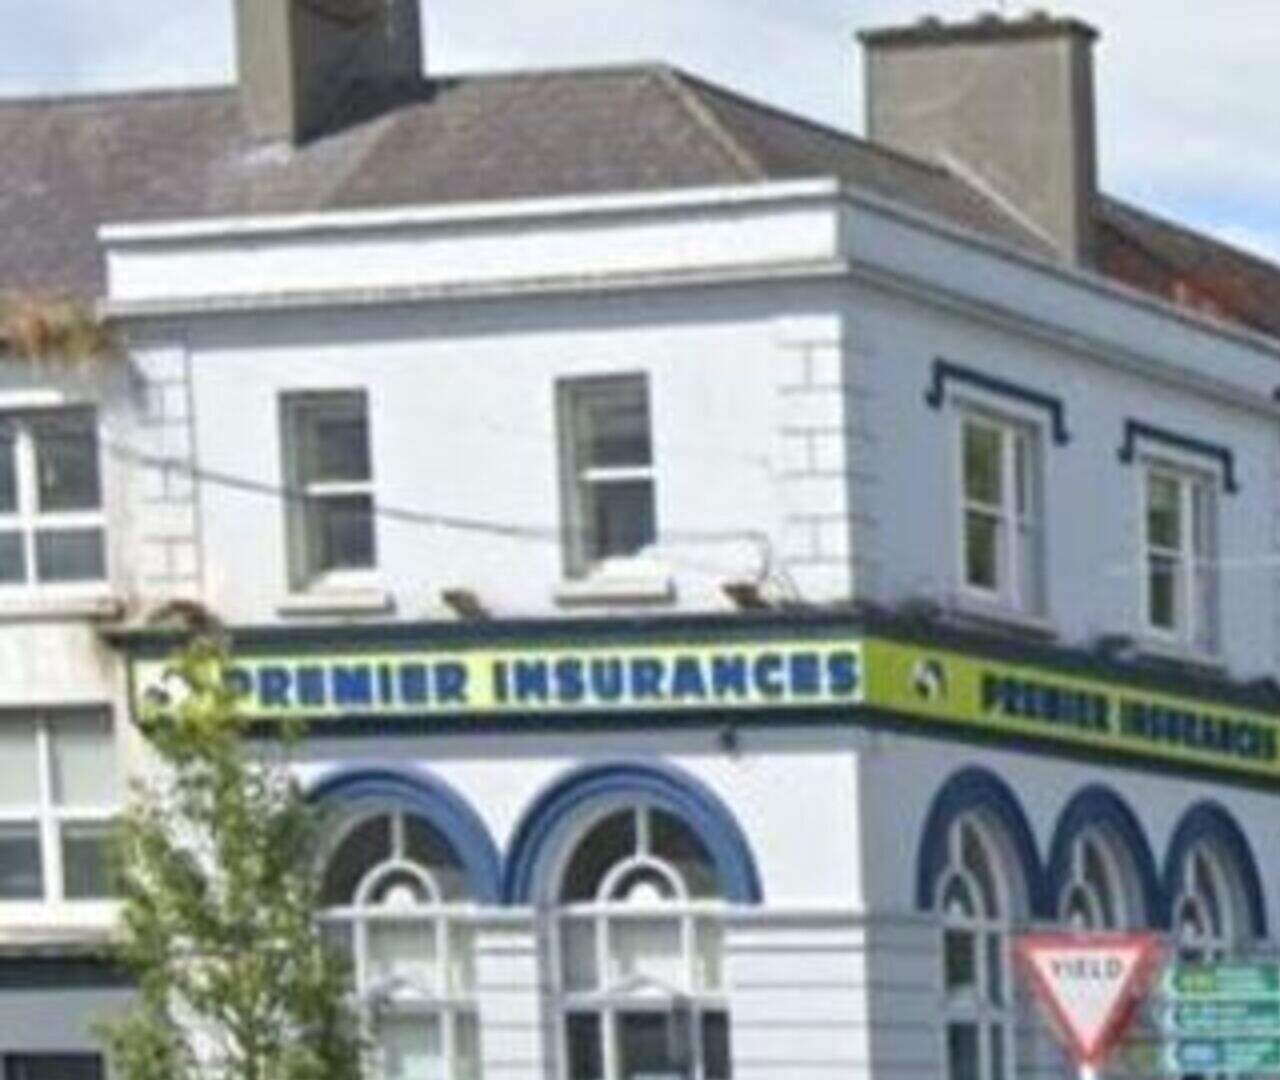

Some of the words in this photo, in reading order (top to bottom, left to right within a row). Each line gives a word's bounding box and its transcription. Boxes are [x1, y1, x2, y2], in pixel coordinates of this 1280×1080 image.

[224, 661, 468, 708] PREMIER
[493, 651, 860, 704] INSURANCES
[1050, 960, 1125, 980] YIELD
